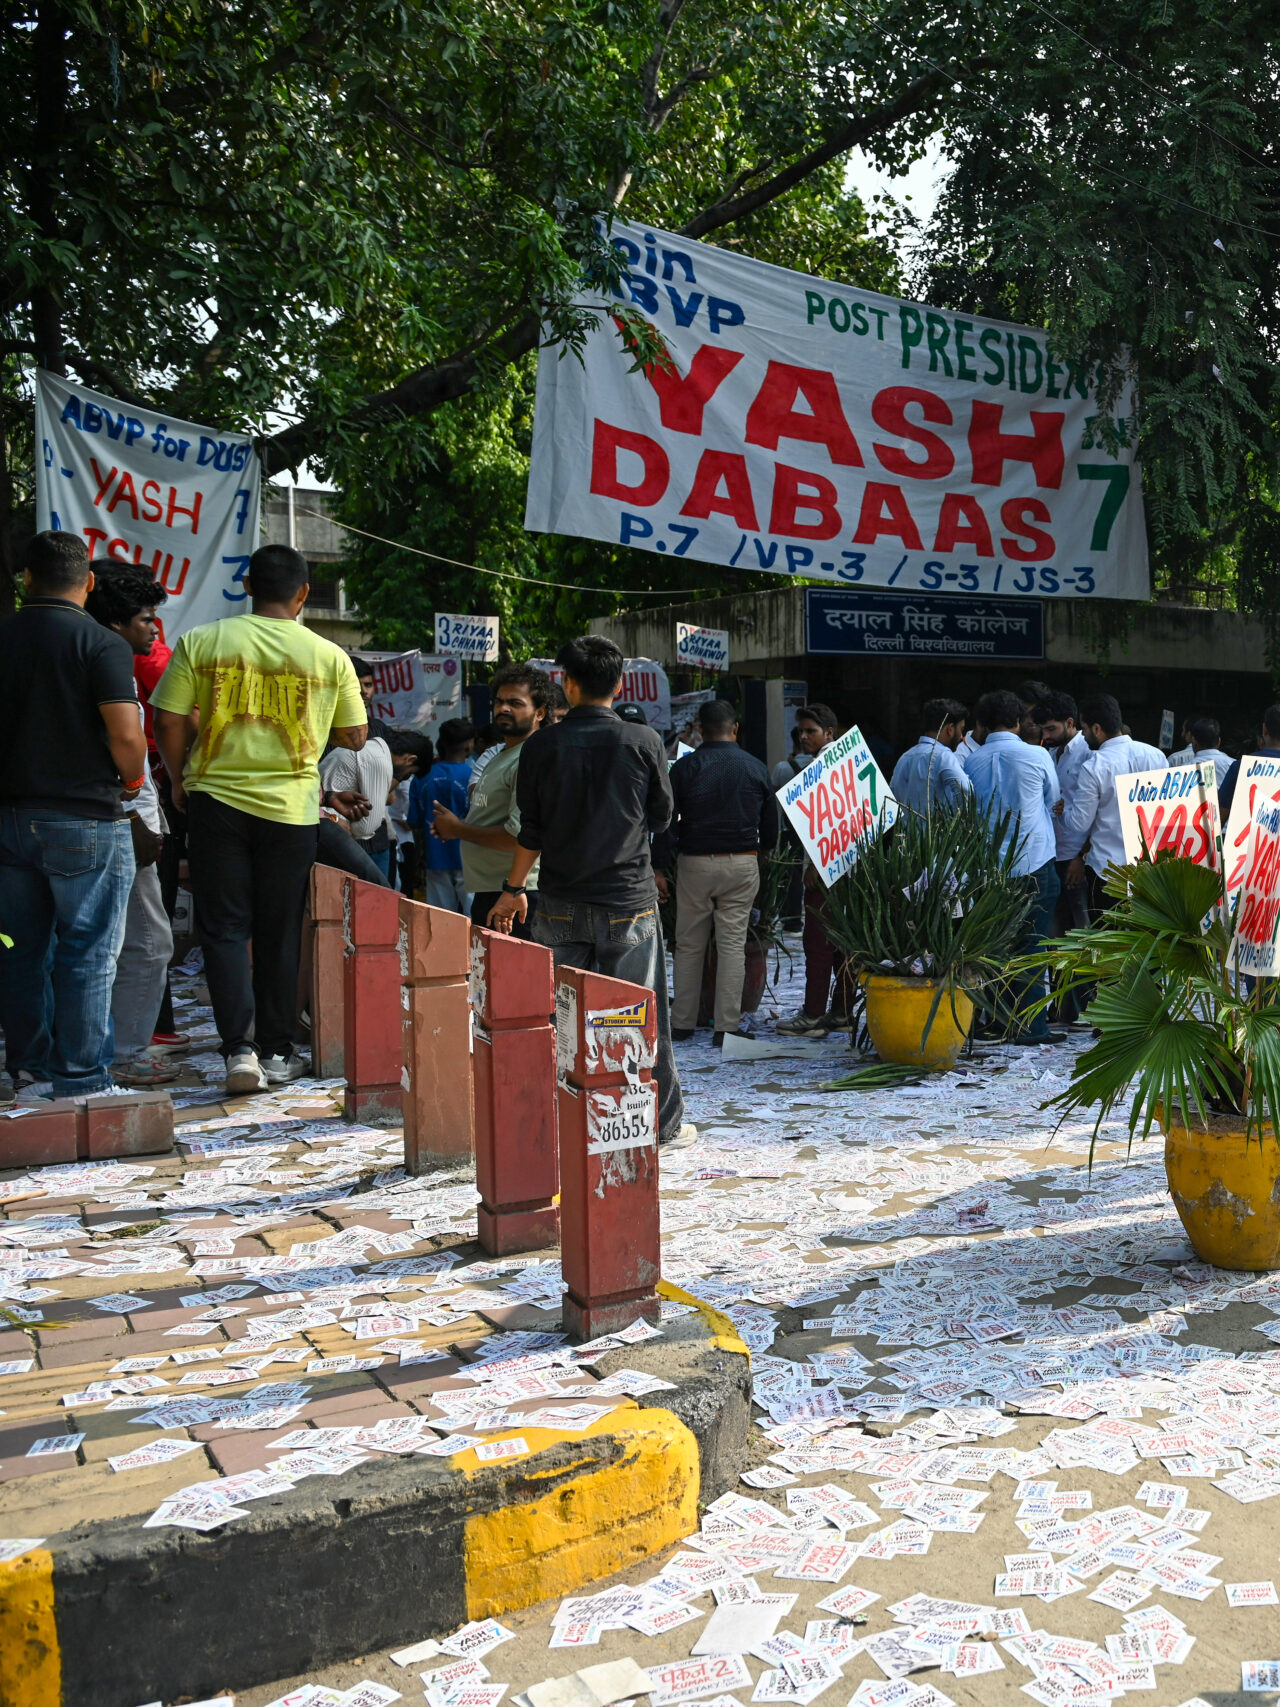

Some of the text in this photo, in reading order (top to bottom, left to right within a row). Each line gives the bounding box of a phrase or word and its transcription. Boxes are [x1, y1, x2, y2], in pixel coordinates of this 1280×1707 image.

[805, 290, 1106, 400] POST PRESIDEN
[613, 315, 1065, 489] YASH
[61, 395, 145, 446] ABVP
[152, 423, 190, 461] for
[90, 457, 203, 535] YASH
[590, 417, 1056, 562] DABAAS
[1078, 464, 1130, 552] 7
[619, 511, 699, 556] P.7
[222, 555, 250, 601] 3
[438, 616, 450, 647] 3
[452, 623, 493, 638] RIYAA
[824, 604, 1029, 635] दयाल सिंह कॉलेज
[451, 636, 495, 651] CHHAWDI
[679, 625, 689, 654] 3
[689, 634, 721, 650] RIYAA
[863, 632, 996, 653] दिल्ली विश्वविद्यालय
[855, 750, 869, 768] B.N.
[1246, 760, 1274, 779] Join
[786, 783, 803, 806] Join
[796, 758, 858, 840] YASH
[858, 762, 878, 816] 7
[1129, 779, 1158, 803] Join
[817, 798, 873, 867] DABAAS
[672, 1676, 712, 1691] KUMAR
[713, 1660, 734, 1678] 2
[659, 1681, 720, 1703] SECRETARY
